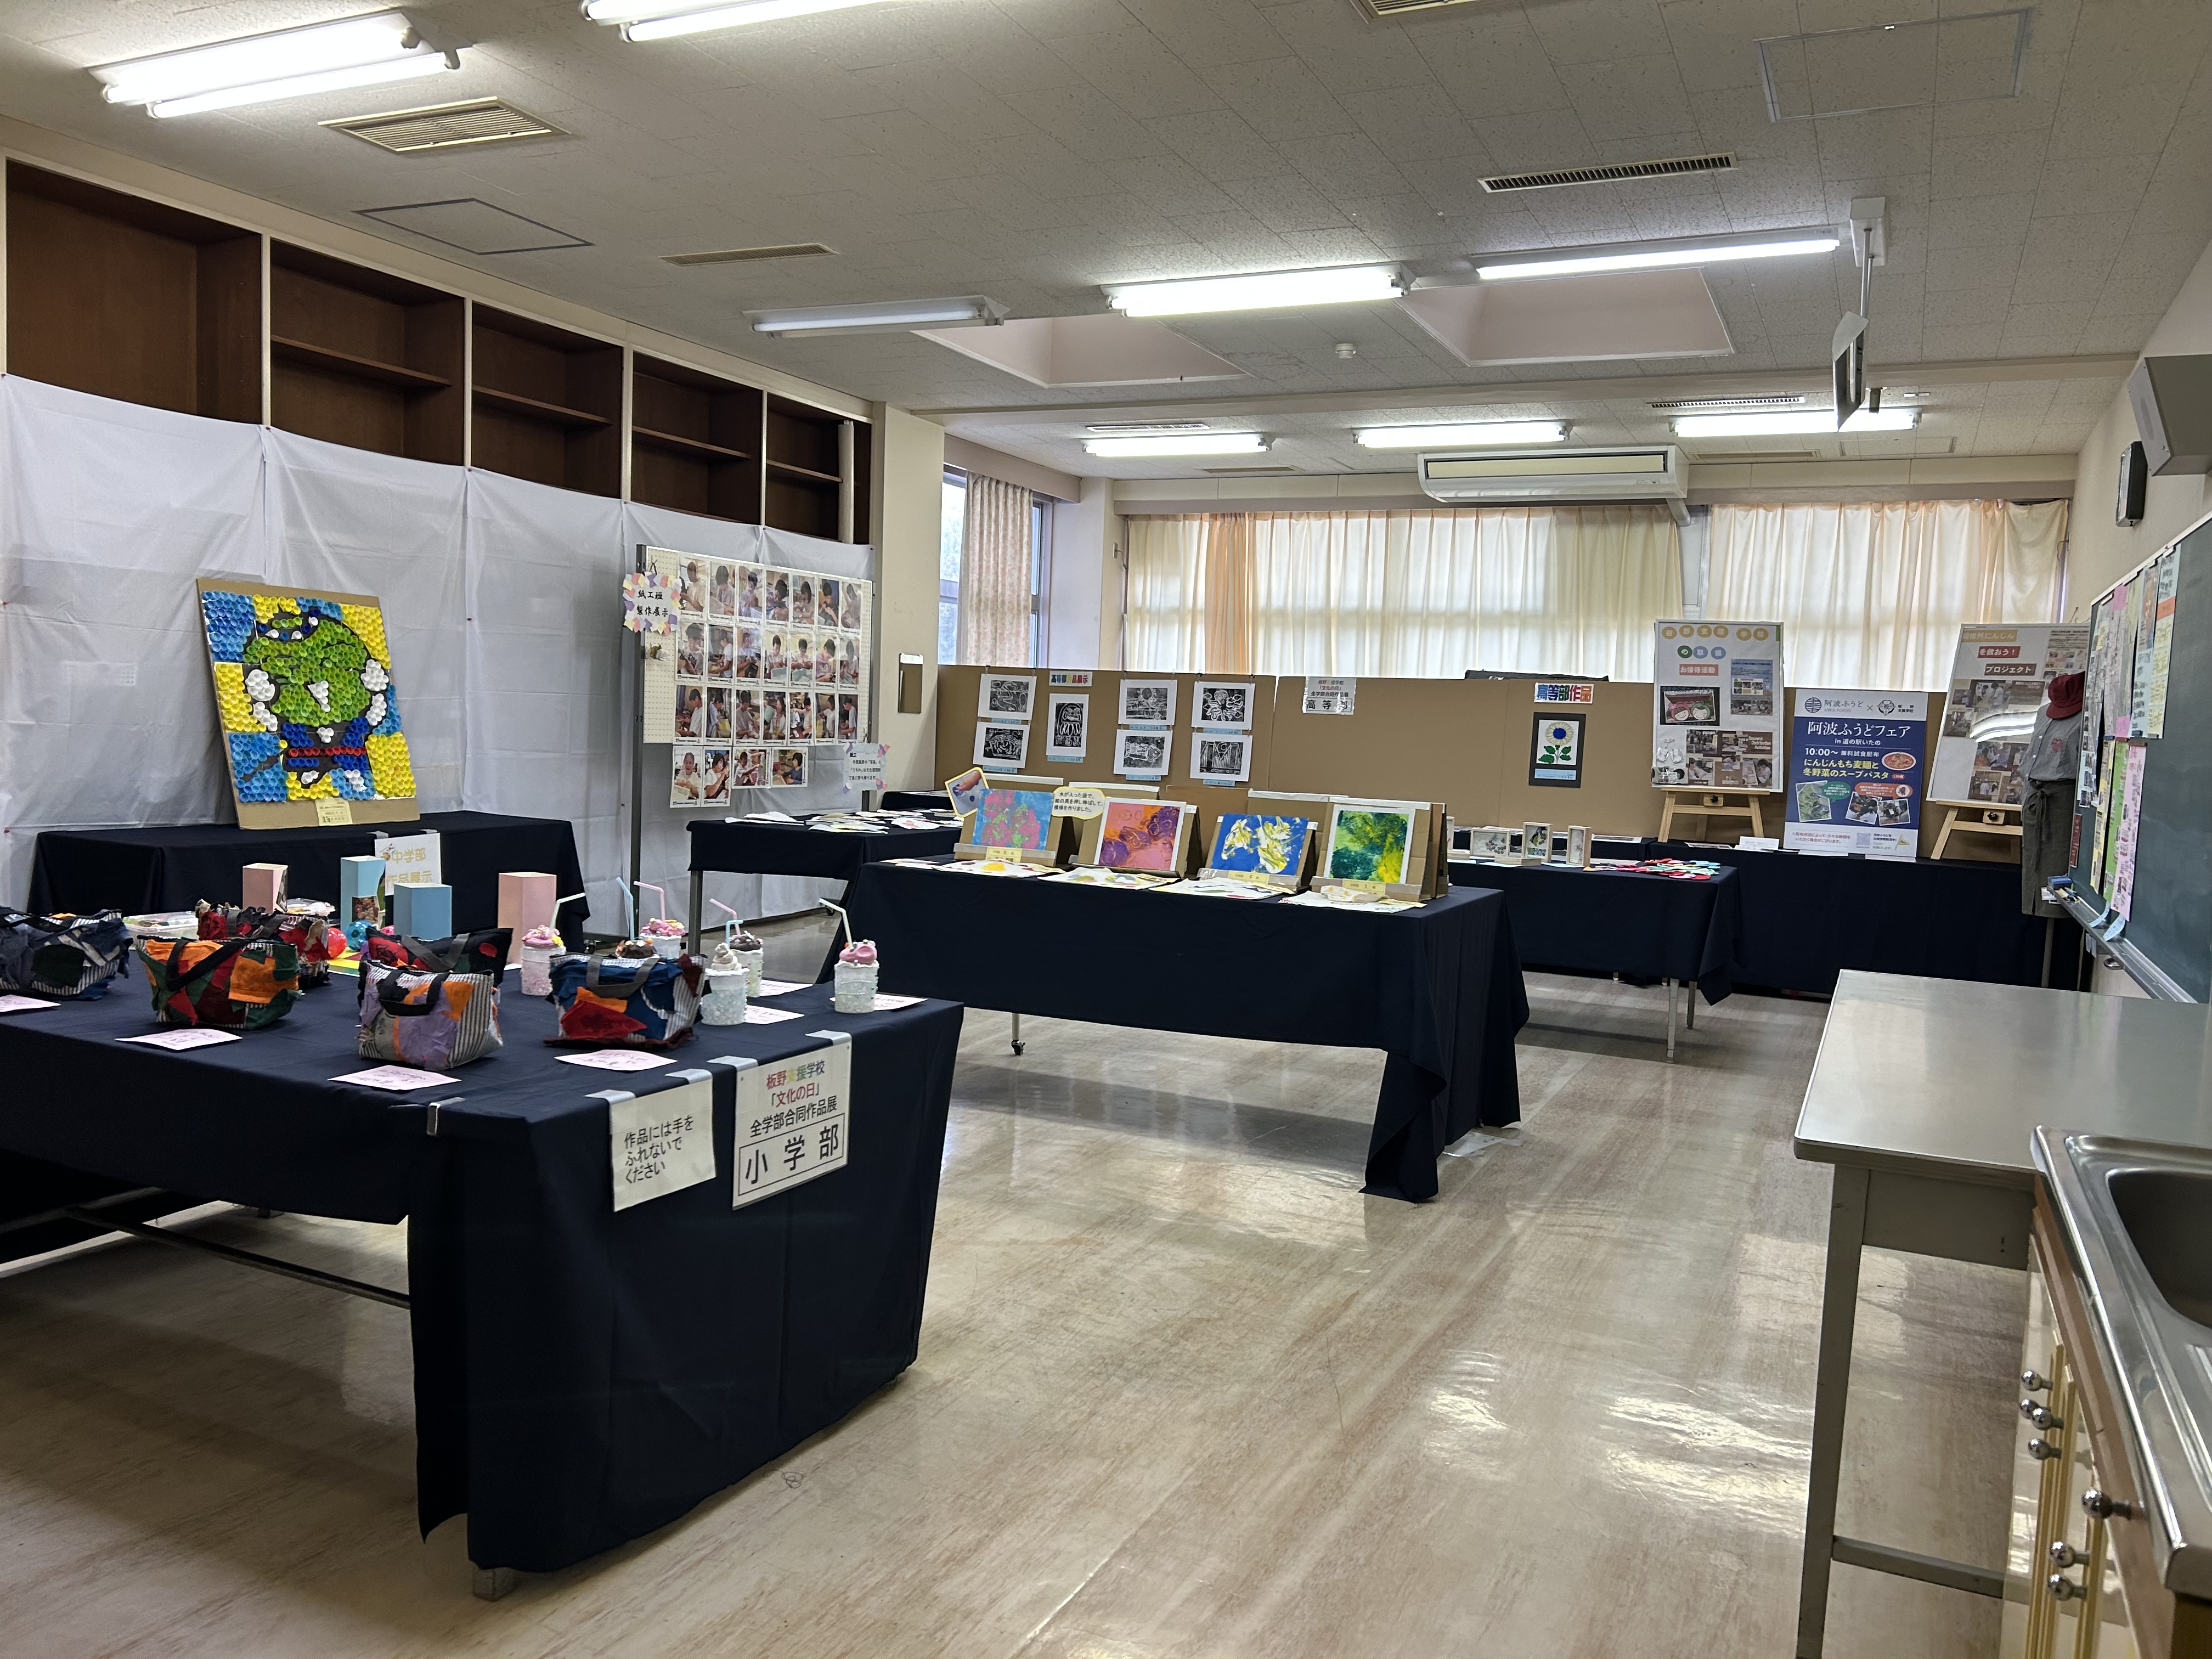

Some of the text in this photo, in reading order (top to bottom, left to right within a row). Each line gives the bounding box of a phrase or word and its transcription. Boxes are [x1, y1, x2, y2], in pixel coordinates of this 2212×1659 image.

[637, 589, 663, 600] 紙工班
[636, 605, 668, 617] 製作展示
[1985, 665, 2032, 674] プロジェクト
[1537, 684, 1592, 702] 高等部作品
[1306, 699, 1348, 711] 高等部
[1807, 721, 1911, 738] 阿波ふうどフェア
[1804, 758, 1879, 770] にんじんもち麦麺と
[1803, 768, 1889, 780] 冬野菜のスープパスタ
[391, 847, 426, 864] 中学部
[766, 1059, 826, 1090] 板野支援学校
[771, 1082, 821, 1107] 「文化の日」
[750, 1095, 838, 1138] 全学部合同作品展
[624, 1115, 694, 1150] 作品には手を
[624, 1137, 683, 1167] ふれないで
[745, 1122, 839, 1184] 小学部
[624, 1159, 666, 1184] ください
